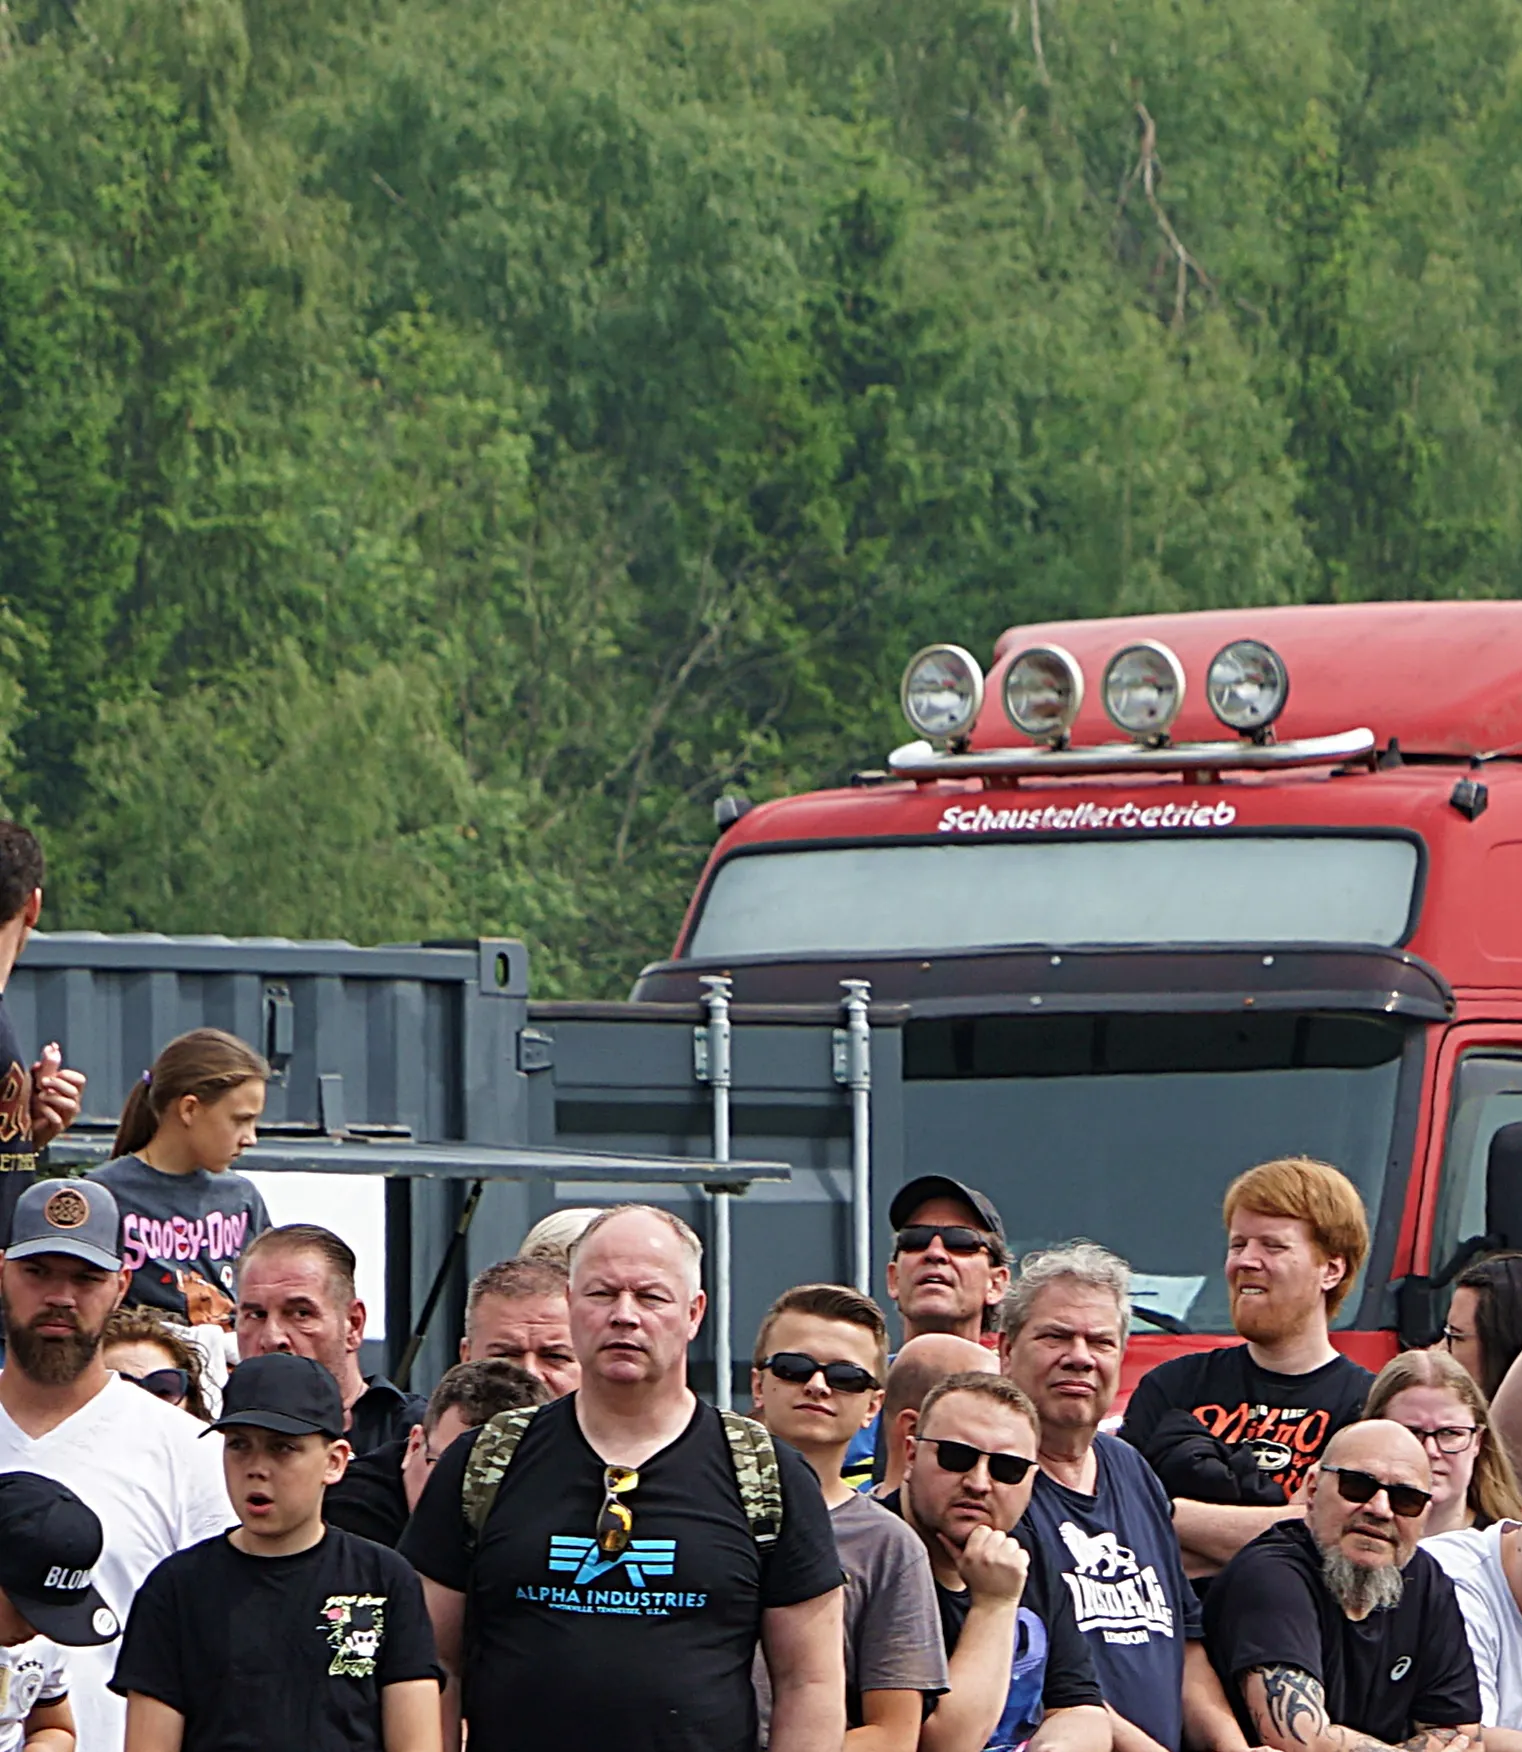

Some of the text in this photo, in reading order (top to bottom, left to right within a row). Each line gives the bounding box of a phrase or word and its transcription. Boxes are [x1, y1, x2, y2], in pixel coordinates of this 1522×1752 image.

[938, 801, 1236, 832] Schaustellerbetrieb
[515, 1585, 707, 1607] ALPHA INDUSTRIES
